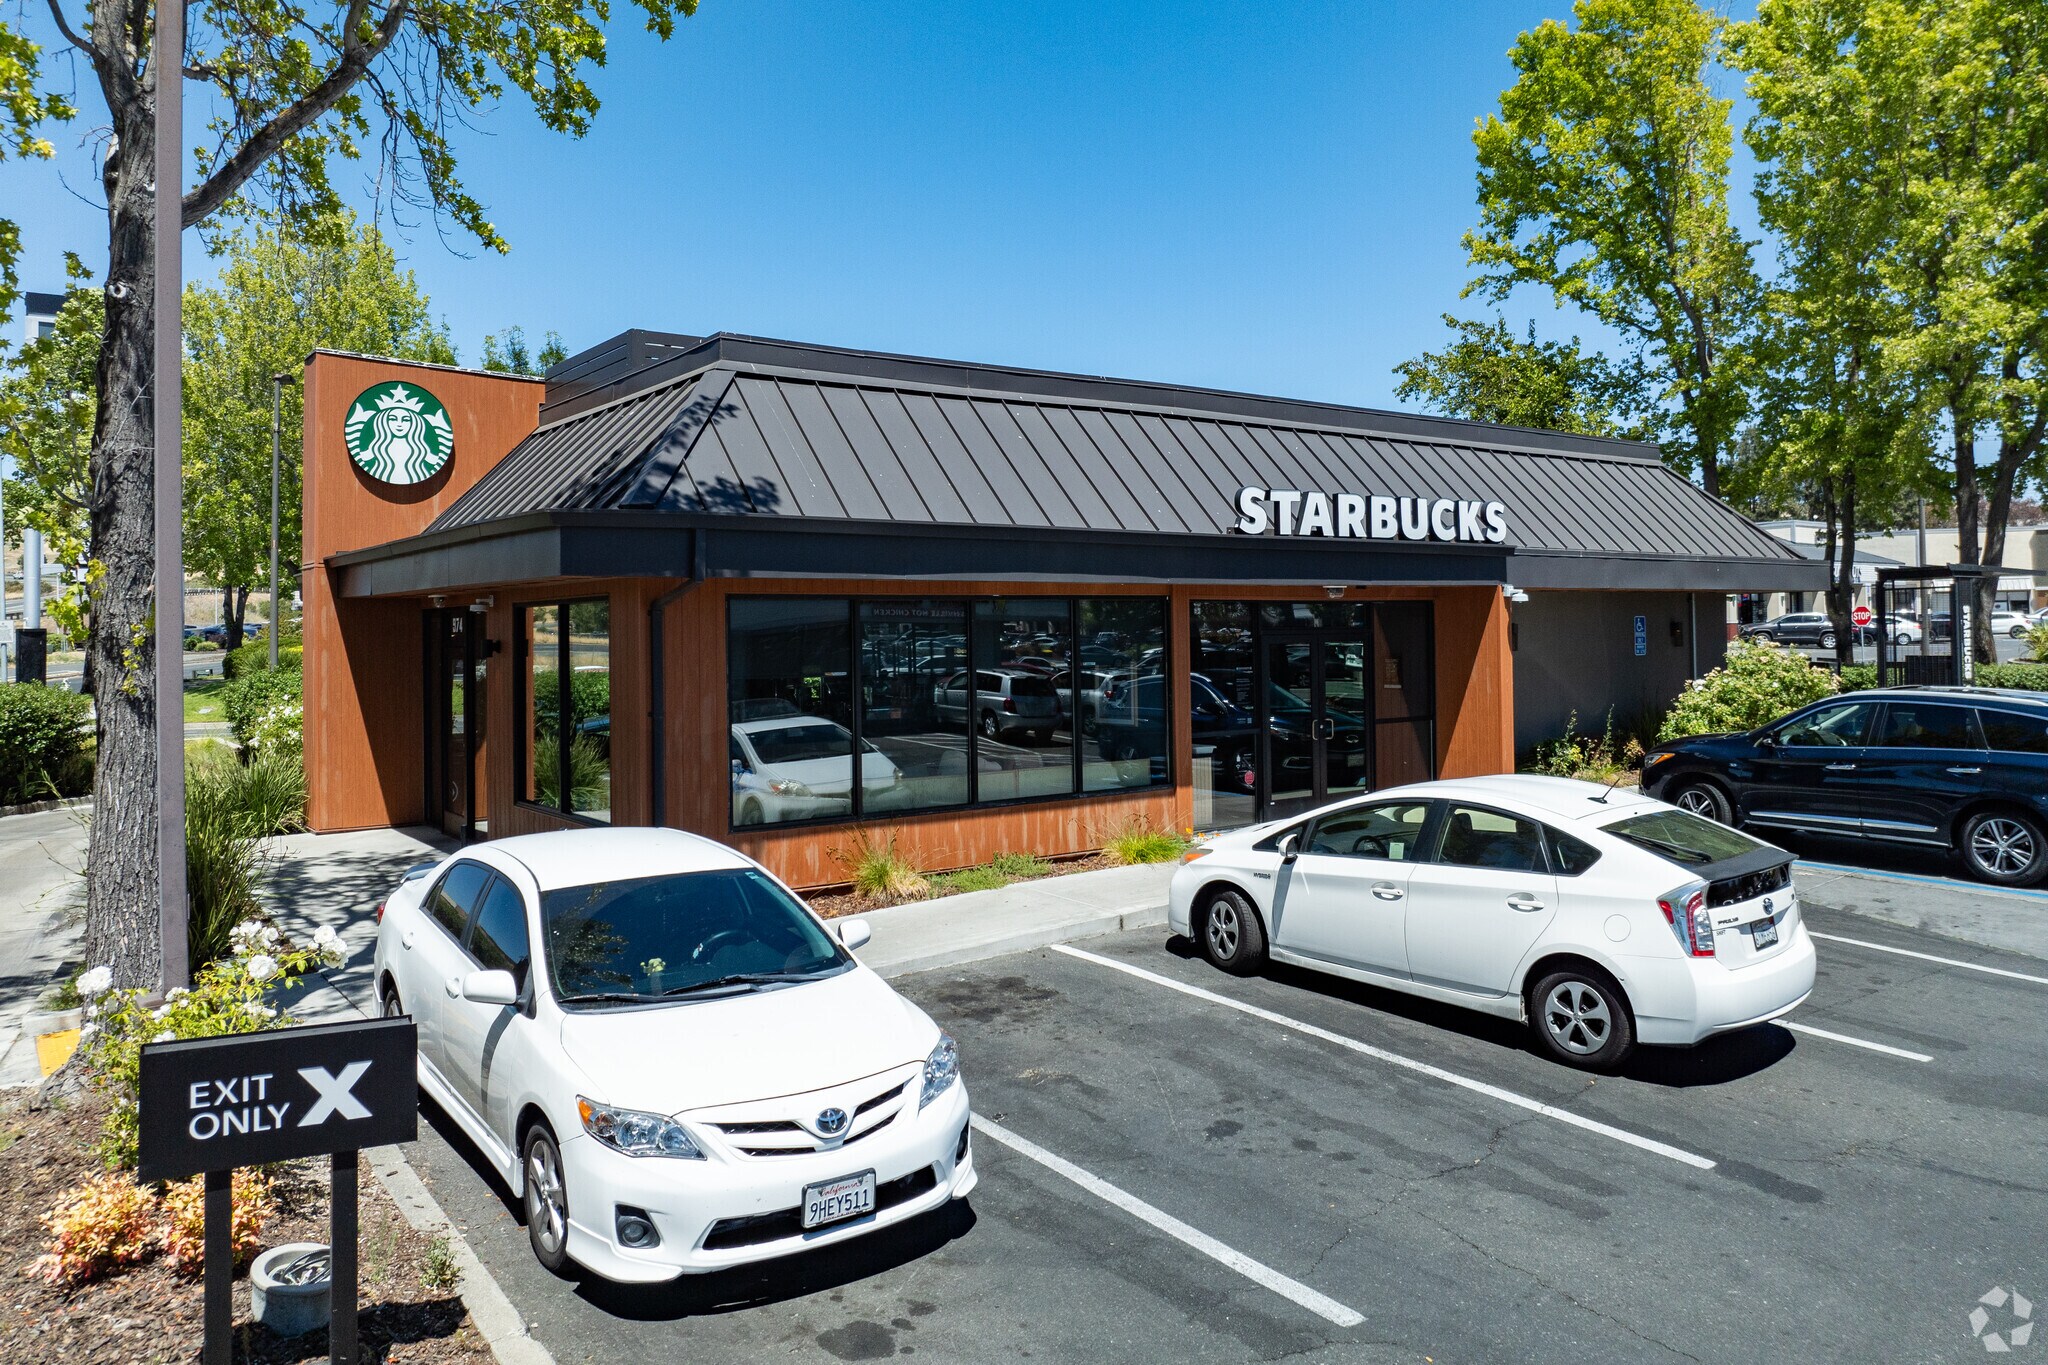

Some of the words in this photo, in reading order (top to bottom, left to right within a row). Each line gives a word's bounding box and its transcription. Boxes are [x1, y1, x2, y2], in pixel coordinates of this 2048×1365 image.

[1236, 486, 1507, 543] STARBUCKS
[1853, 611, 1870, 621] STOP
[1962, 605, 1973, 680] STARBUCKS
[189, 1073, 274, 1109] EXIT
[296, 1059, 374, 1128] X
[188, 1102, 291, 1141] ONLY
[809, 1189, 869, 1222] 9HEY511
[821, 1181, 860, 1198] California
